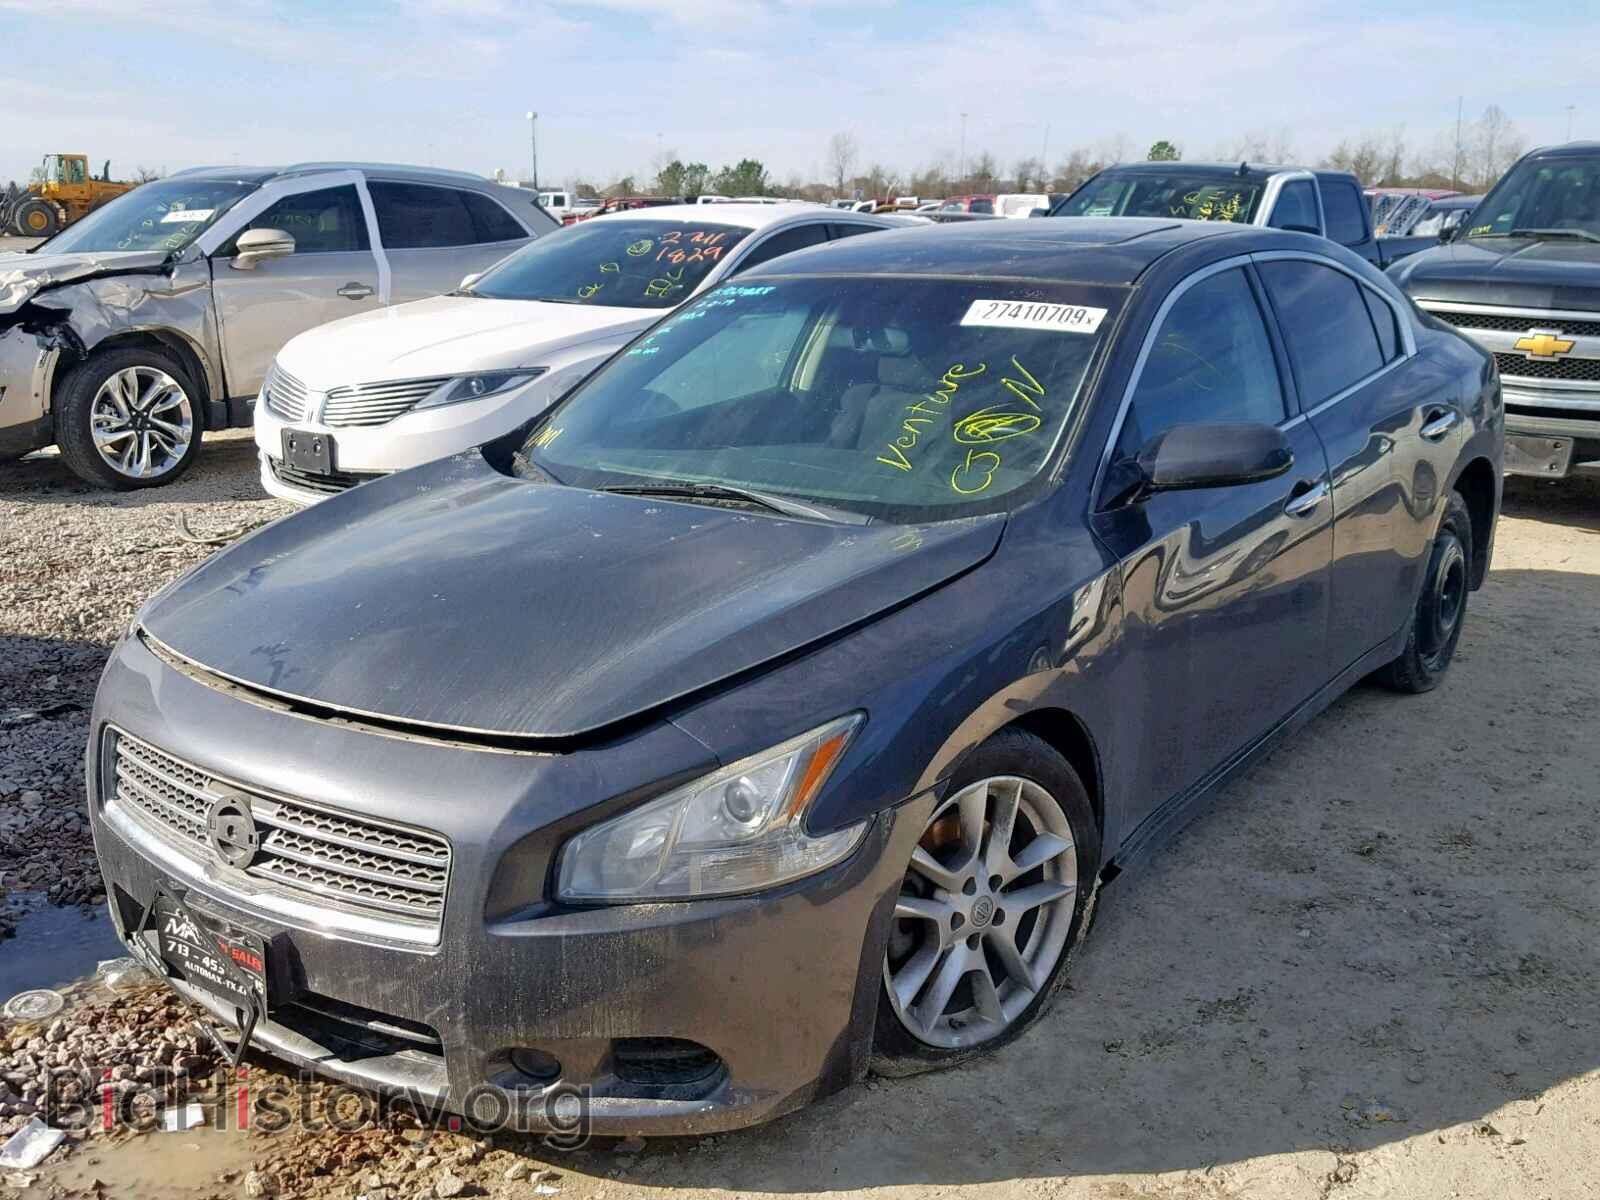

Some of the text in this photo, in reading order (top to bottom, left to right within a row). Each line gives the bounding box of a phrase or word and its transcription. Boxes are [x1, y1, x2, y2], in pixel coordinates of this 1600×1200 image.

[876, 363, 987, 472] Venture
[167, 940, 190, 958] 713
[231, 948, 263, 972] SALES
